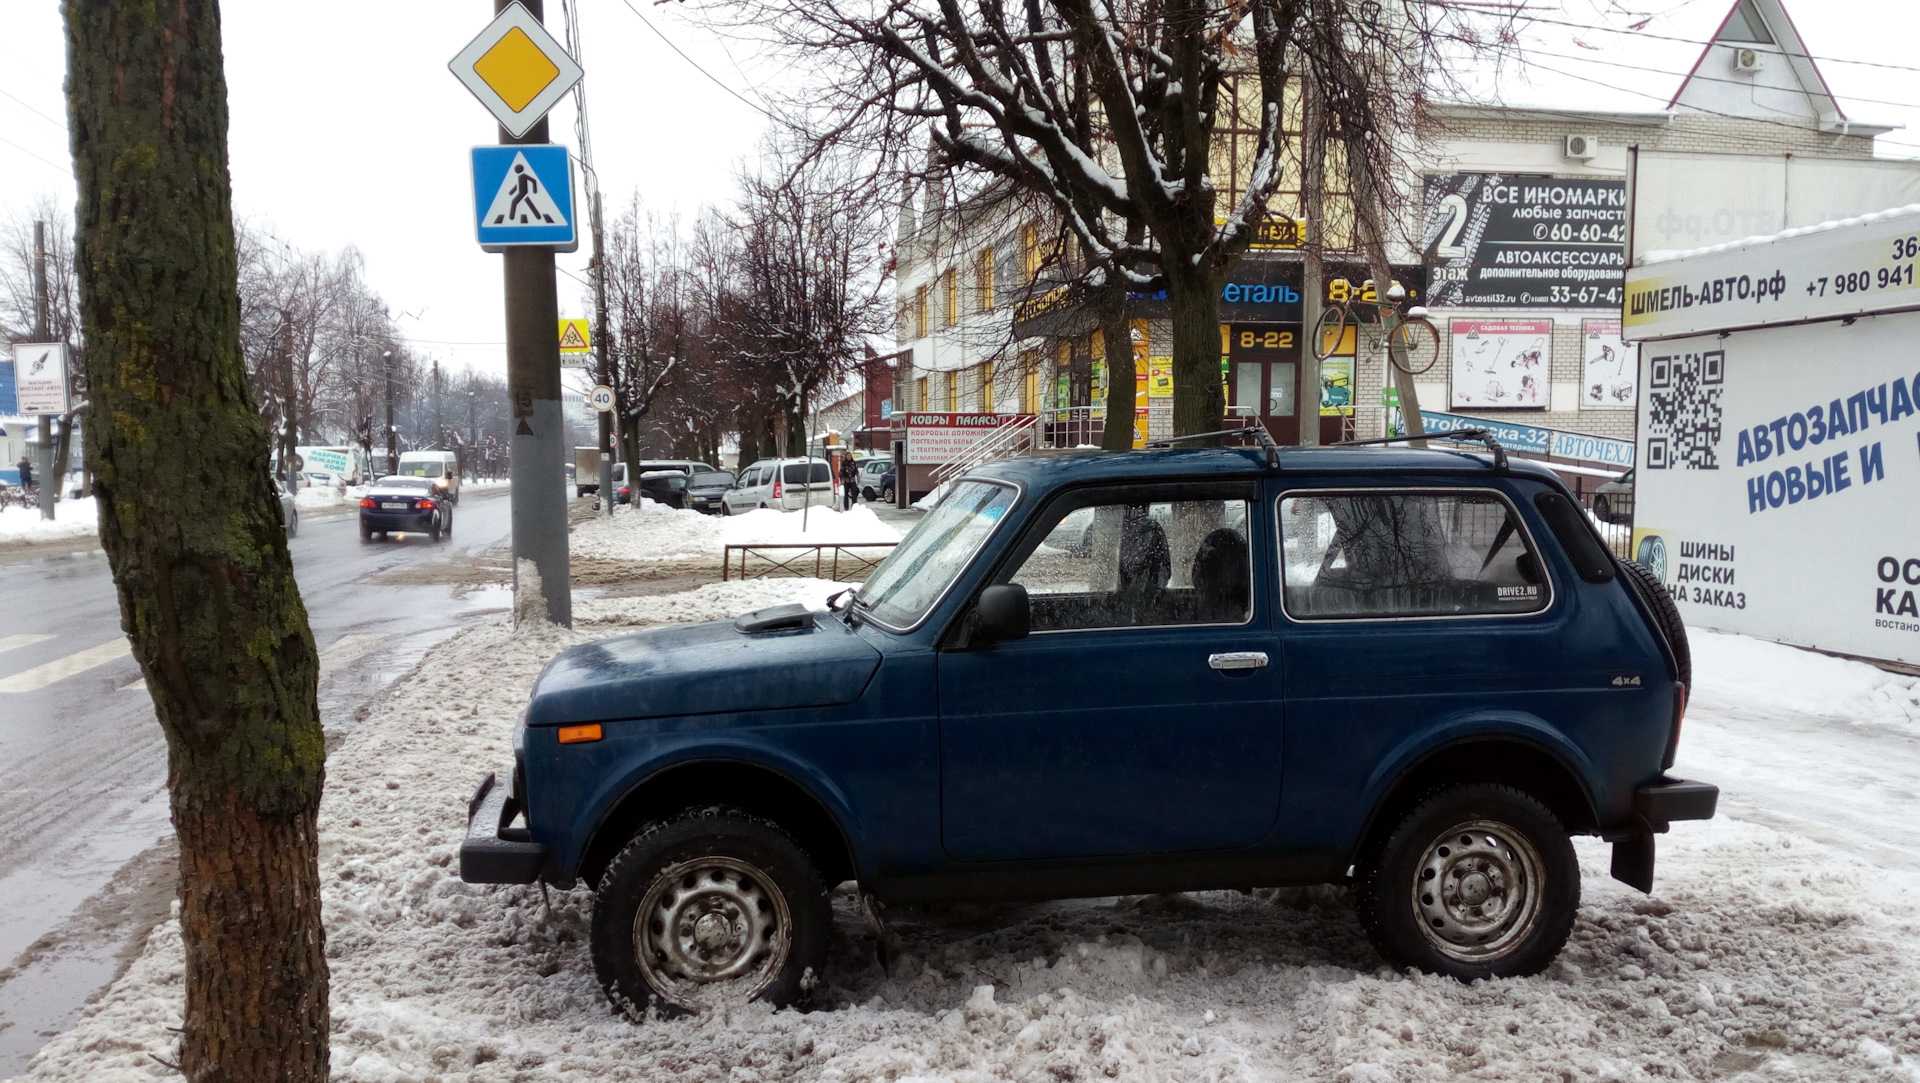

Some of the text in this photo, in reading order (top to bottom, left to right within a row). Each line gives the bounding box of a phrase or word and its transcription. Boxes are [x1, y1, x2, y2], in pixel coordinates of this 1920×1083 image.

[1482, 186, 1518, 203] ВСЕ
[1512, 205, 1562, 219] любые
[1438, 194, 1468, 258] 2
[1433, 266, 1469, 281] этаж
[1480, 266, 1559, 279] дополнительное
[1221, 283, 1299, 303] еталь
[1329, 278, 1400, 302] 8-2
[1630, 263, 1914, 315] ШМЕЛЬ-АВТО.рф +7 980 941
[1465, 293, 1516, 303] avtostil32.ru
[1241, 331, 1293, 348] 8-22
[594, 393, 610, 403] 40
[910, 415, 949, 425] КОВРЫ
[308, 455, 346, 466] ОБЖАРКИ
[311, 450, 347, 461] ФАБРИКА
[324, 463, 345, 472] КОФЕ
[1747, 451, 1852, 515] НОВЫЕ
[1859, 441, 1885, 485] И
[1680, 541, 1735, 562] ШИНЫ
[1677, 563, 1735, 585] ДИСКИ
[1497, 585, 1537, 596] DRIVE2.RU
[1667, 583, 1747, 610] НА ЗАКАЗ
